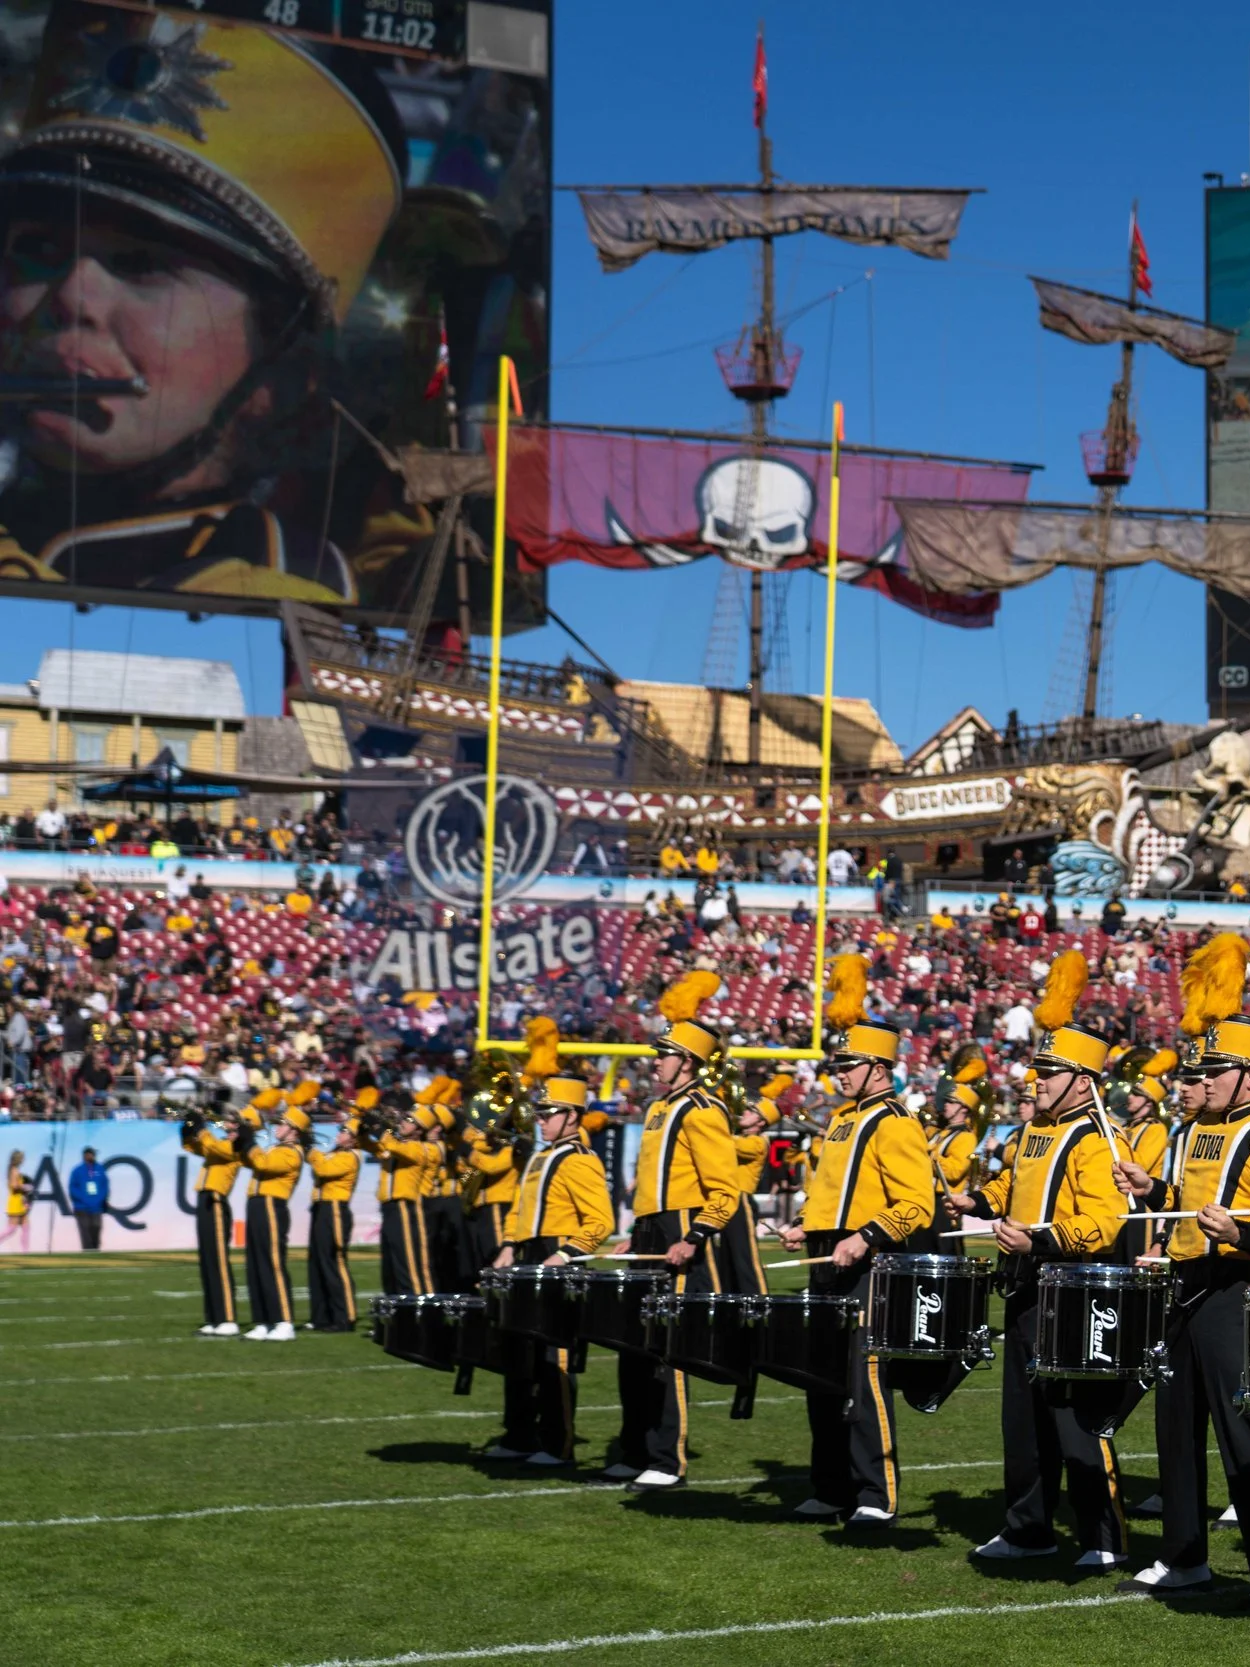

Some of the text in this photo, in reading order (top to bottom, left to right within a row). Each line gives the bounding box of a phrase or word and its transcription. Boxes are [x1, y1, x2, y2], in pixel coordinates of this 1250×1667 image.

[361, 13, 436, 50] 11:02
[1221, 670, 1246, 685] CC
[894, 781, 1006, 816] BUCCANEERS
[366, 914, 595, 992] Allstate
[1191, 1133, 1226, 1161] IOWA
[915, 1284, 942, 1344] Pearl
[1090, 1298, 1118, 1363] Pearl
